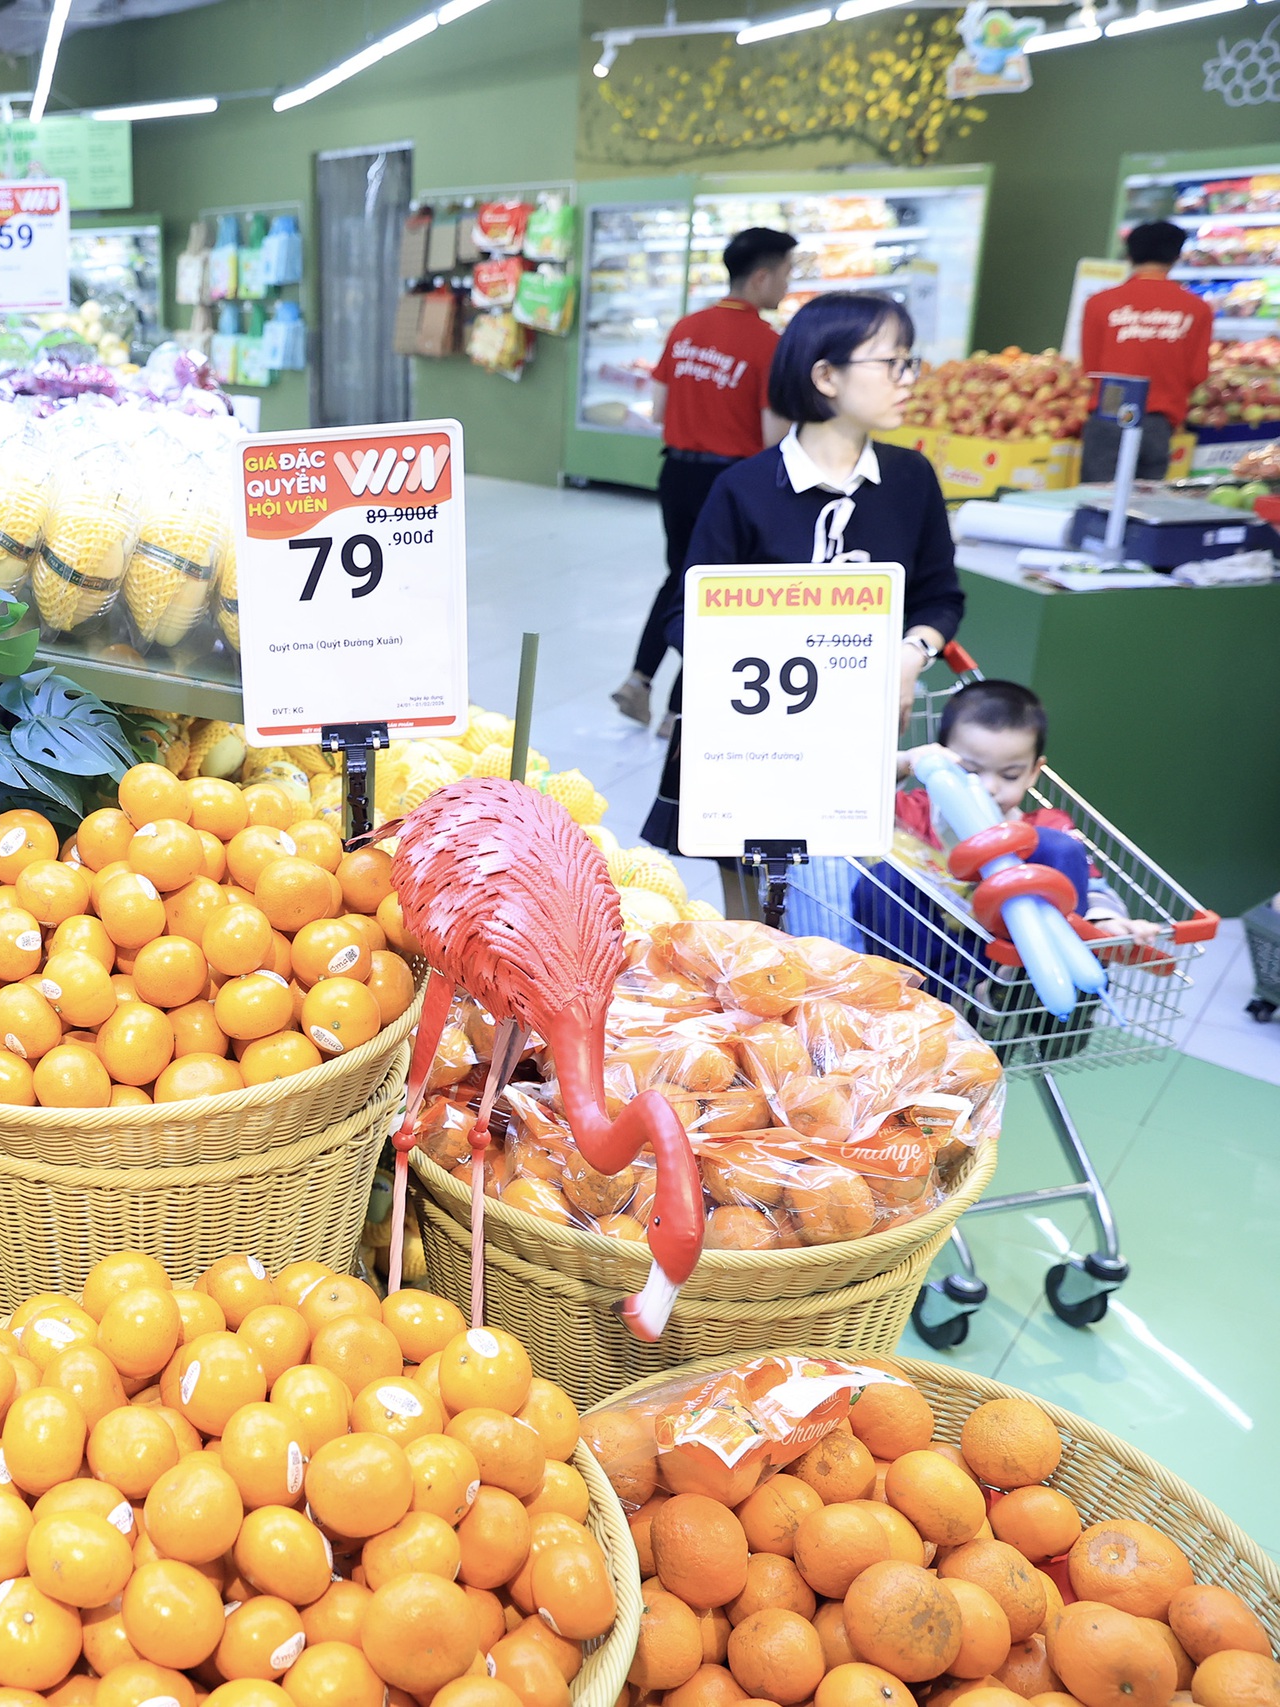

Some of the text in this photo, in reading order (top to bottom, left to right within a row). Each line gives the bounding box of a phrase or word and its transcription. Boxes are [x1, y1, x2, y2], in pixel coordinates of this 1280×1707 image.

[245, 452, 277, 472] GIÁ
[278, 448, 326, 474] ĐẶC
[246, 472, 327, 498] QUYỀN
[248, 495, 327, 519] HỘI VIÊN
[366, 505, 439, 524] 89.900đ
[288, 533, 384, 601] 79
[705, 581, 883, 611] KHUYẾN MẠI
[269, 635, 404, 653] Quýt Oma (Quýt Đường Xuân)
[806, 634, 873, 648] 67.900đ
[730, 656, 819, 715] 39
[272, 706, 304, 716] ĐVT: KG
[704, 751, 804, 762] Quýt Sim (Quýt đường)
